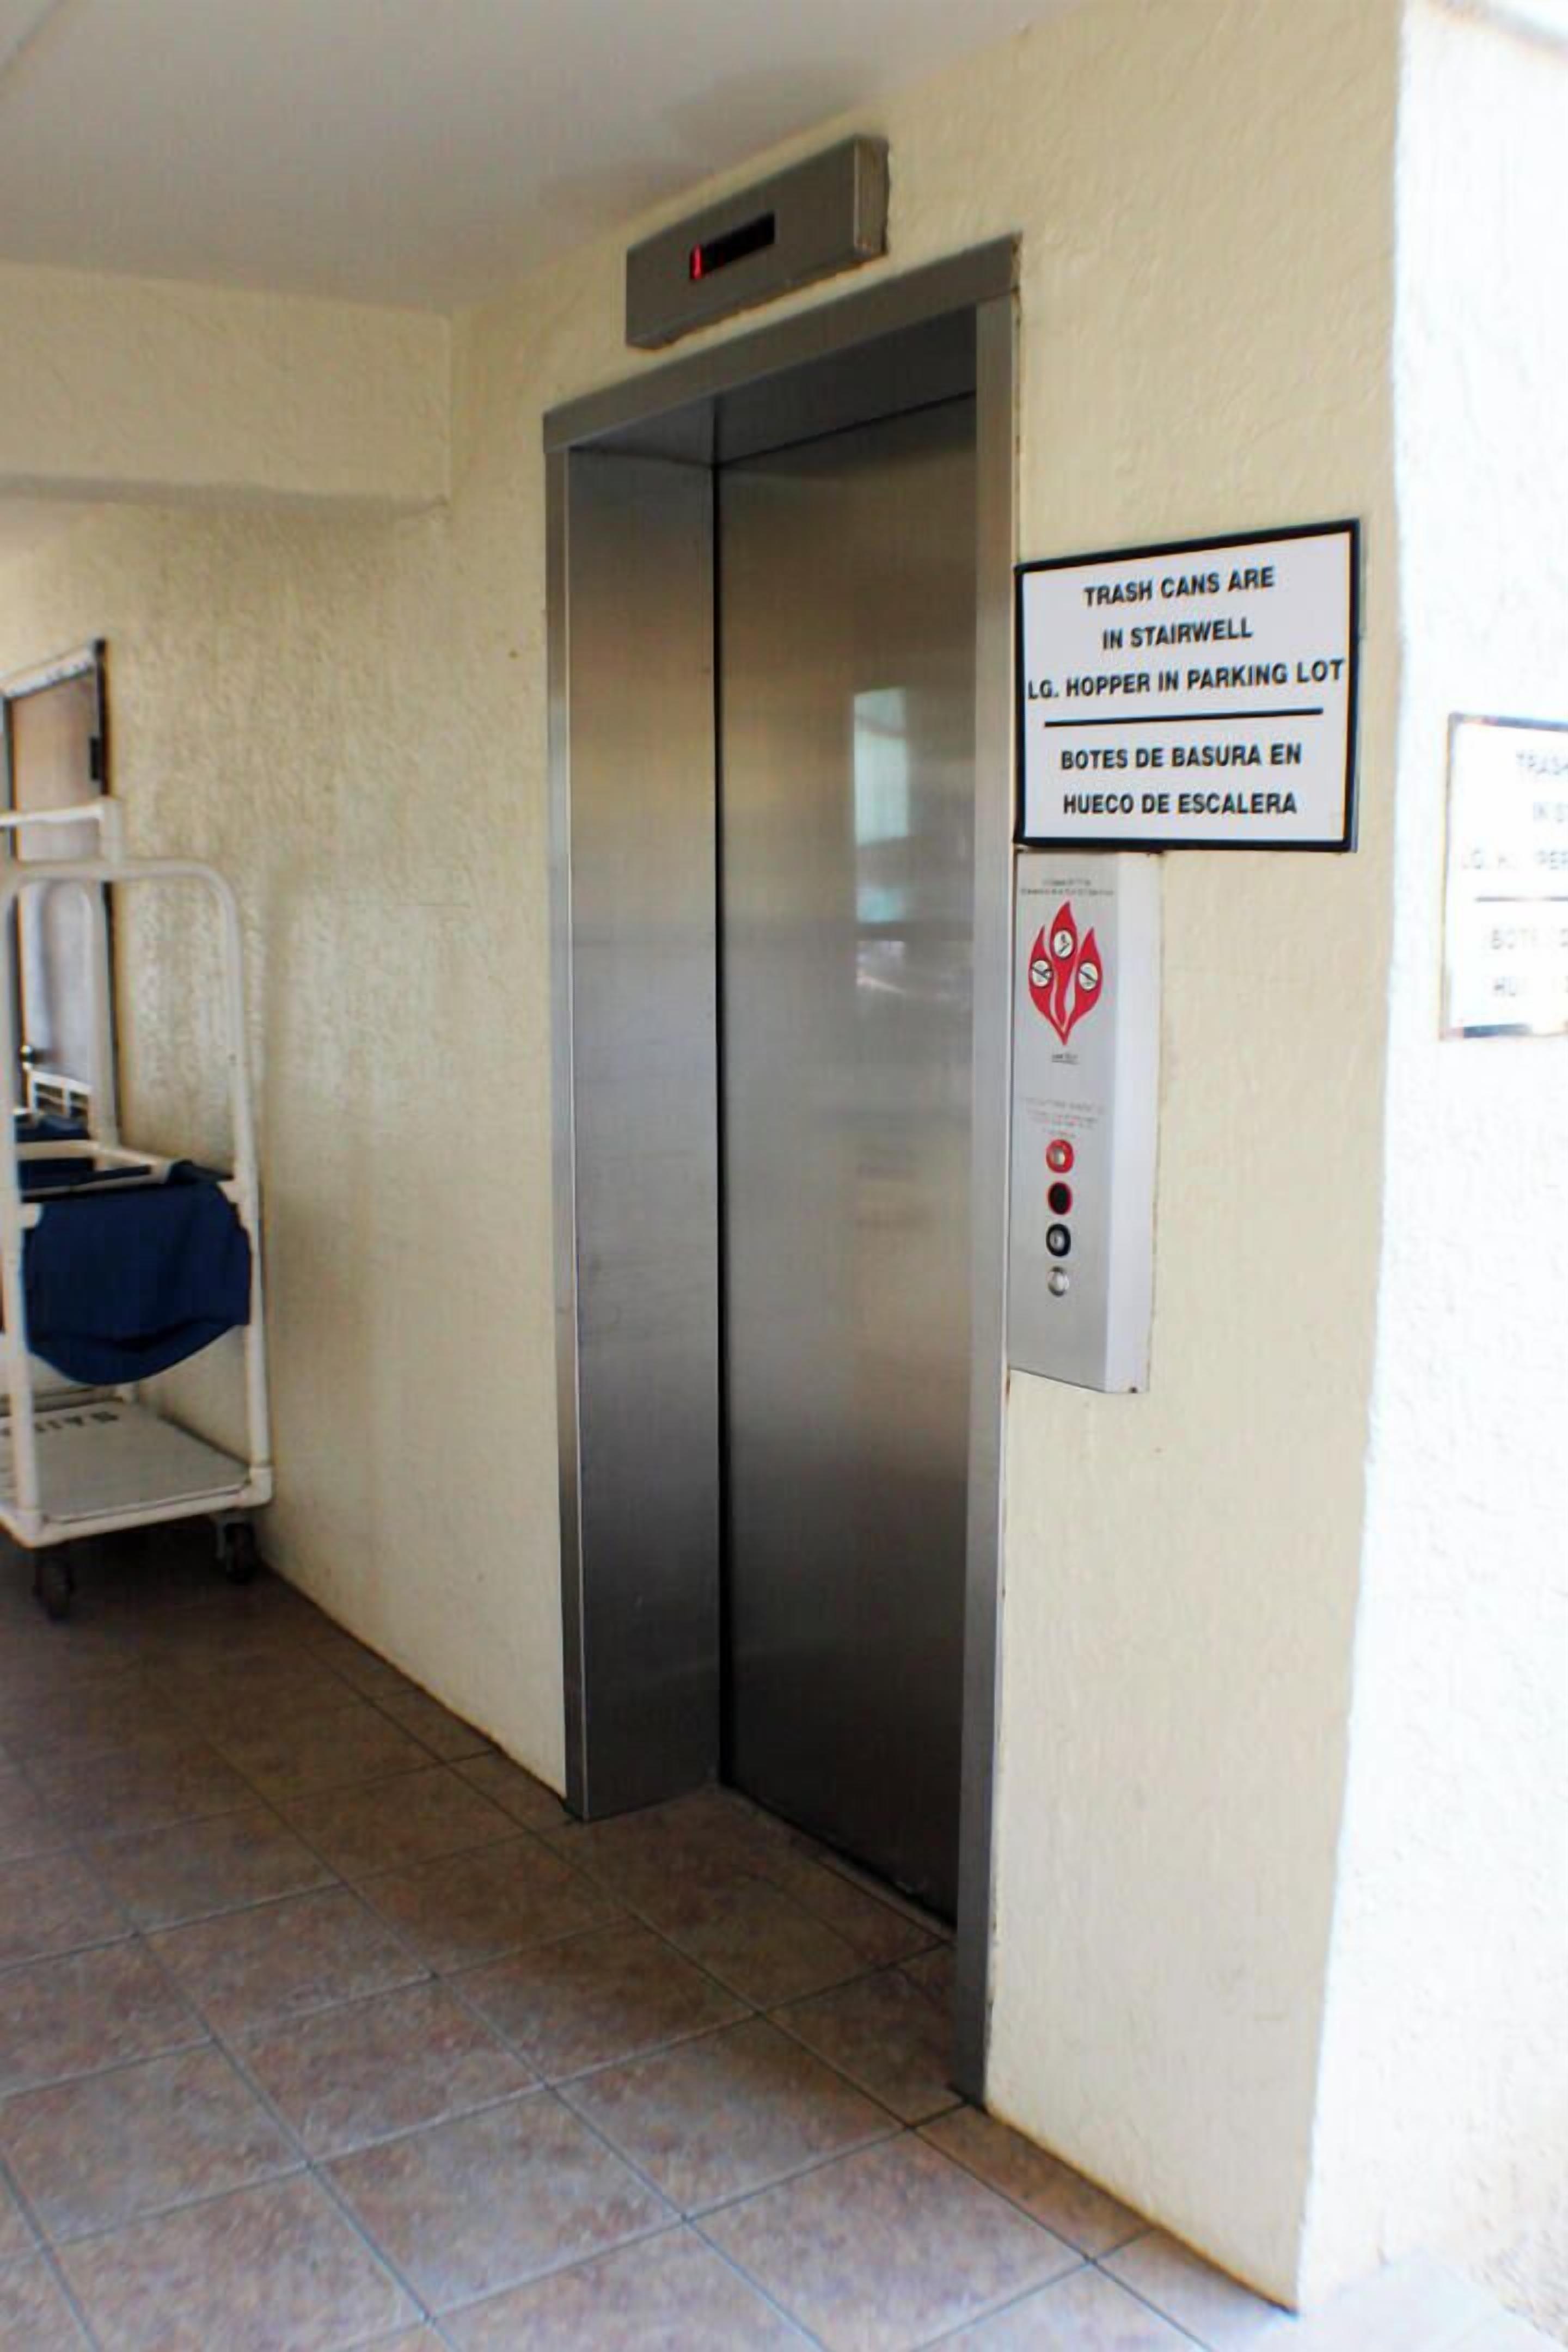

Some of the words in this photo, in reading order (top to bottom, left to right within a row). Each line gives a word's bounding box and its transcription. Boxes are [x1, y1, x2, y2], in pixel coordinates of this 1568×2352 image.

[1084, 580, 1153, 607] TRASH
[1160, 572, 1220, 599] CANS
[1228, 566, 1274, 592] ARE
[1102, 629, 1123, 650] IN
[1130, 618, 1252, 648] STAIRWELL
[1028, 679, 1059, 700] LG.
[1066, 672, 1150, 697] HOPPER
[1158, 671, 1179, 691] IN
[1187, 663, 1288, 690] PARKING
[1296, 659, 1344, 683] LOT
[1061, 749, 1128, 770] BOTES
[1135, 747, 1163, 768] DE
[1172, 745, 1261, 767] BASURA
[1270, 743, 1301, 765] EN
[1063, 794, 1134, 814] HUECO
[1142, 793, 1169, 814] DE
[1178, 793, 1297, 814] ESCALERA
